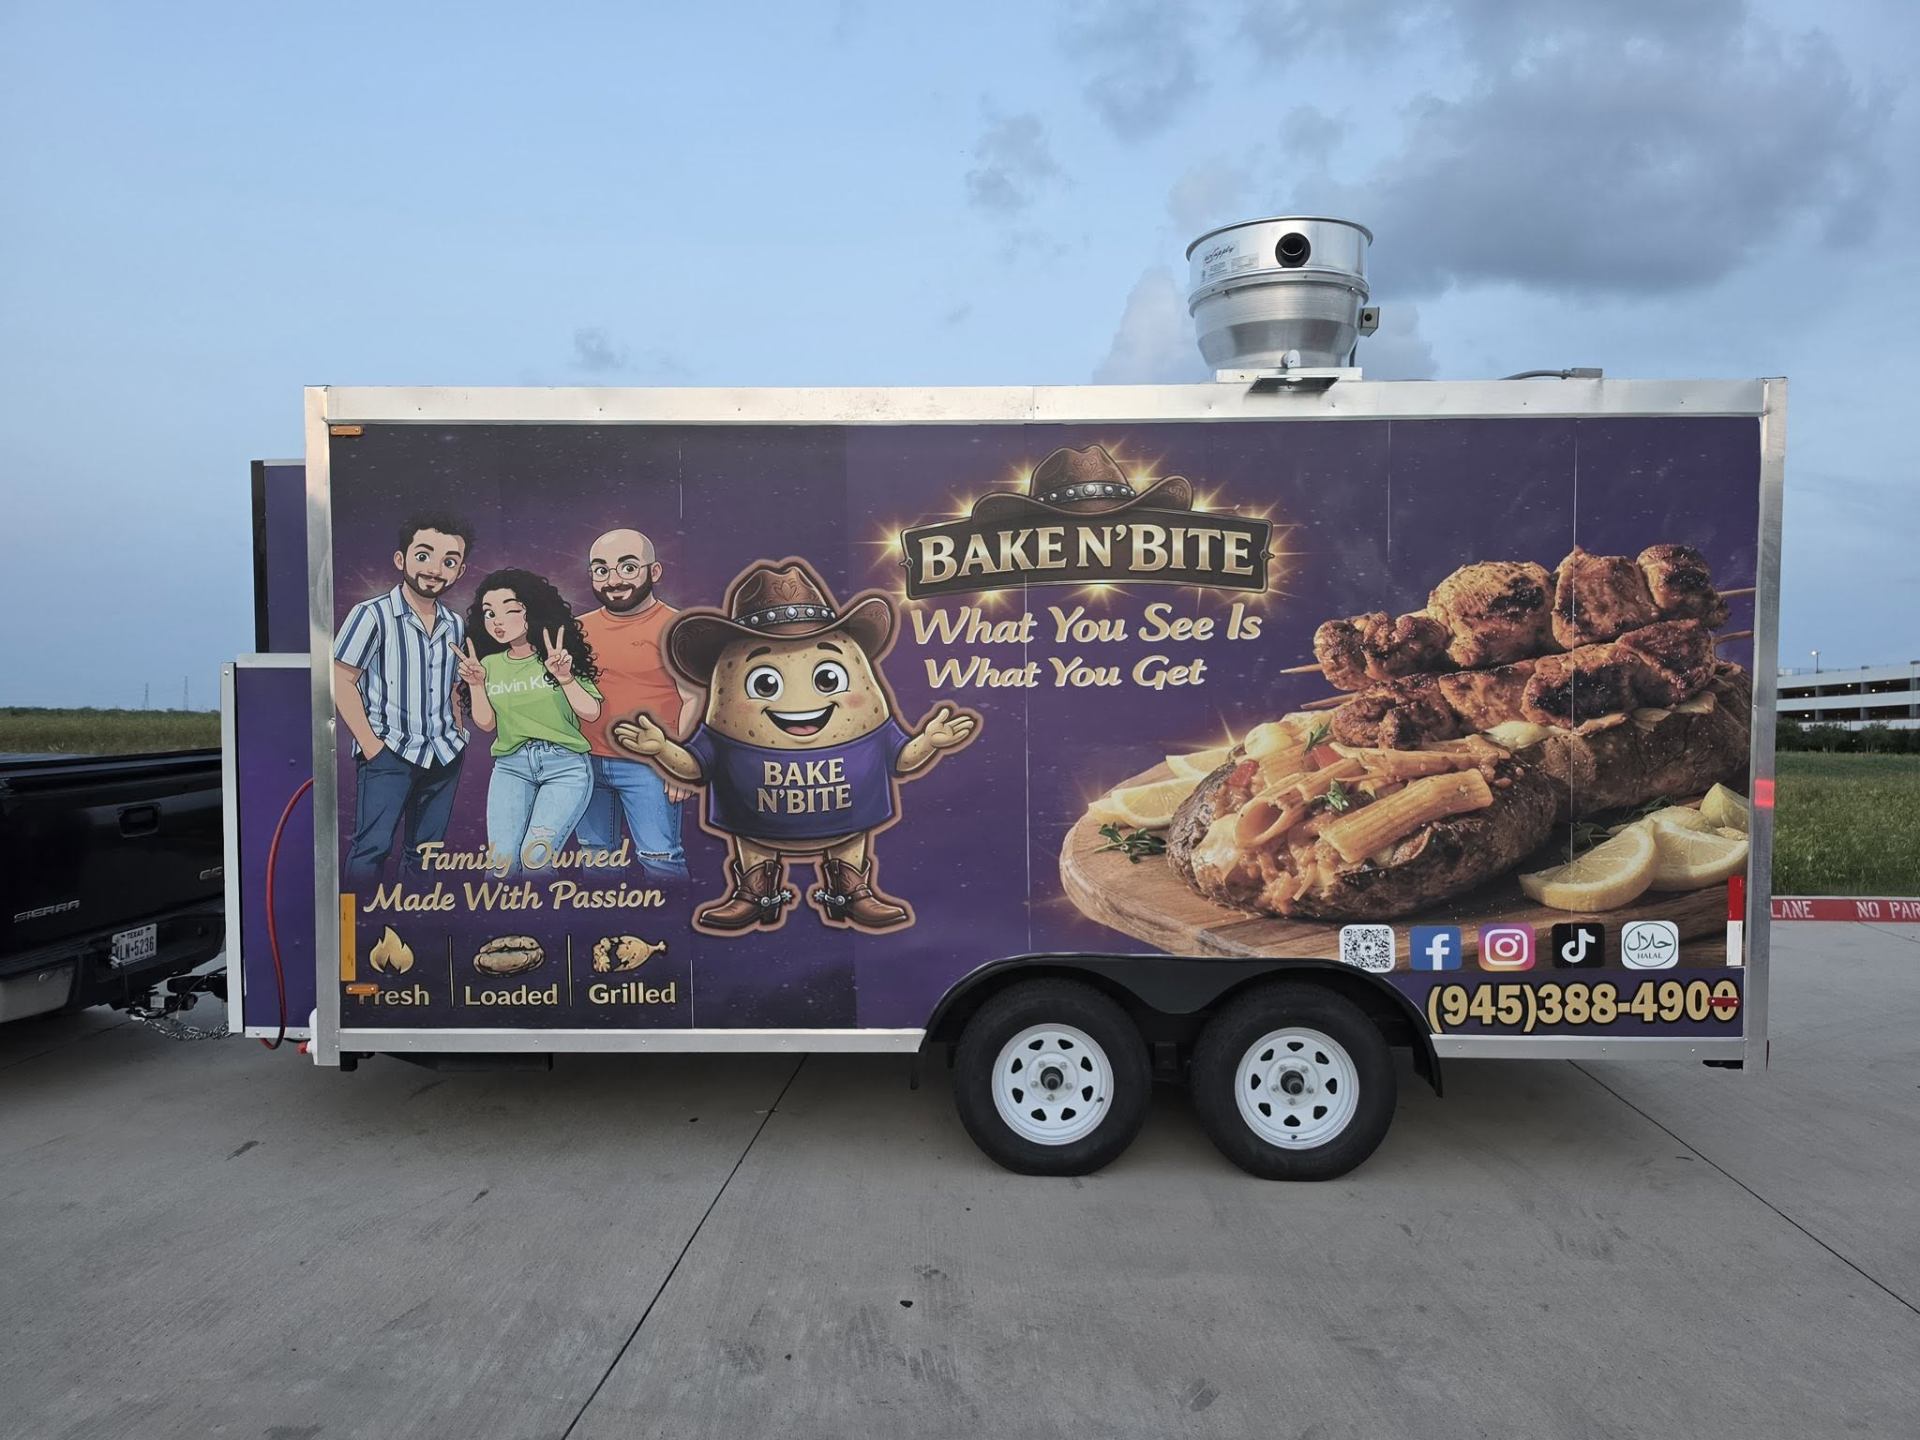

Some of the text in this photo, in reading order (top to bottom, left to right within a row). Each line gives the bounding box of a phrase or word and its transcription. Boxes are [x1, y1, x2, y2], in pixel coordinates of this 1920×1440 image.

[919, 524, 1254, 584] BAKE N'BITE
[911, 603, 1263, 644] What You See Is
[924, 655, 1207, 691] What You Get
[763, 757, 846, 787] BAKE
[757, 784, 852, 814] N'BITE
[416, 838, 631, 878] Family Owned
[363, 880, 665, 912] Made With Passion
[1771, 900, 1814, 918] LANE
[1856, 901, 1880, 918] NO
[14, 899, 80, 924] SIERRA
[1637, 952, 1662, 960] HALAL
[465, 984, 558, 1006] Loaded
[588, 981, 676, 1004] Grilled
[1428, 980, 1738, 1033] (945)388-4900
